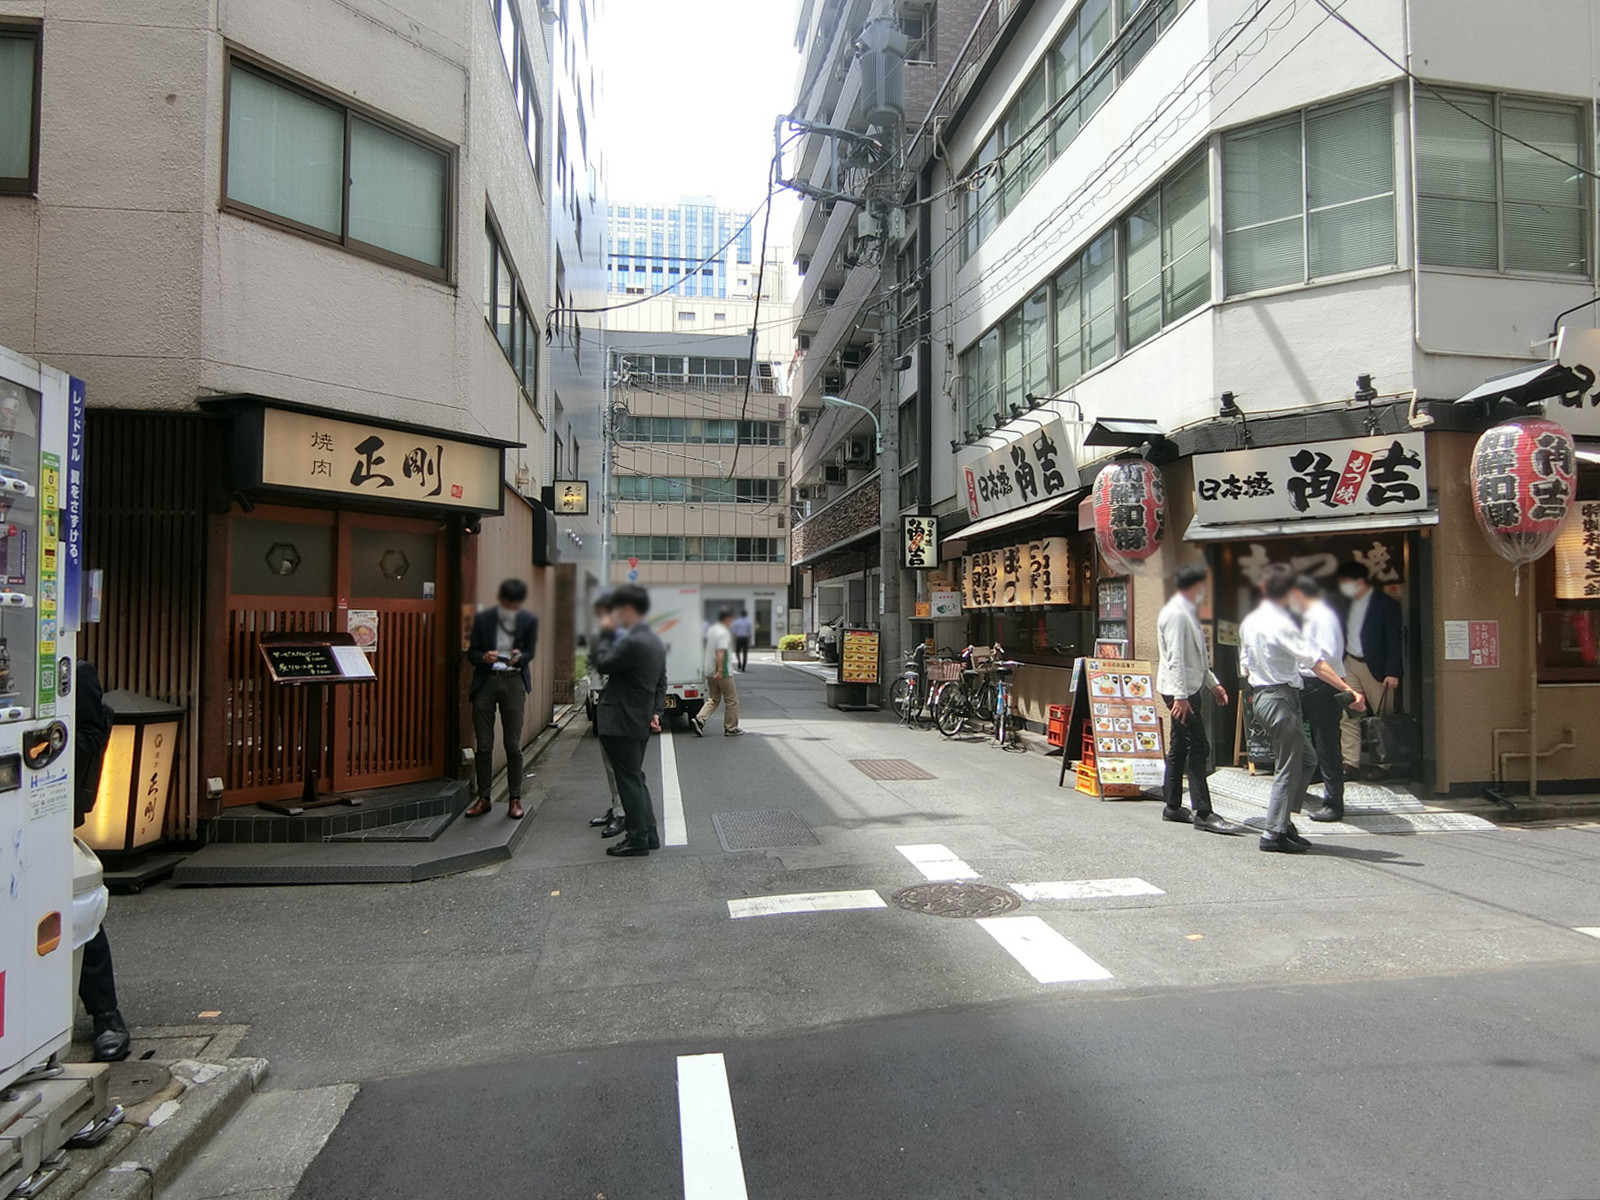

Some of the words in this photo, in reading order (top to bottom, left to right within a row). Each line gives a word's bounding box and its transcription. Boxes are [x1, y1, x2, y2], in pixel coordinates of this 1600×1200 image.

[71, 390, 82, 462] レッドブル
[310, 431, 334, 478] 焼肉
[350, 436, 443, 497] 正剛
[977, 465, 1013, 502] 日本橋
[1010, 429, 1065, 503] 角吉
[1198, 471, 1275, 501] 日本橋
[1286, 440, 1422, 512] 角吉
[1336, 454, 1367, 505] もつ焼
[1531, 433, 1572, 519] 角吉
[906, 518, 925, 566] 角吉
[1481, 624, 1489, 664] お持ち帰り
[144, 772, 159, 823] 正剛
